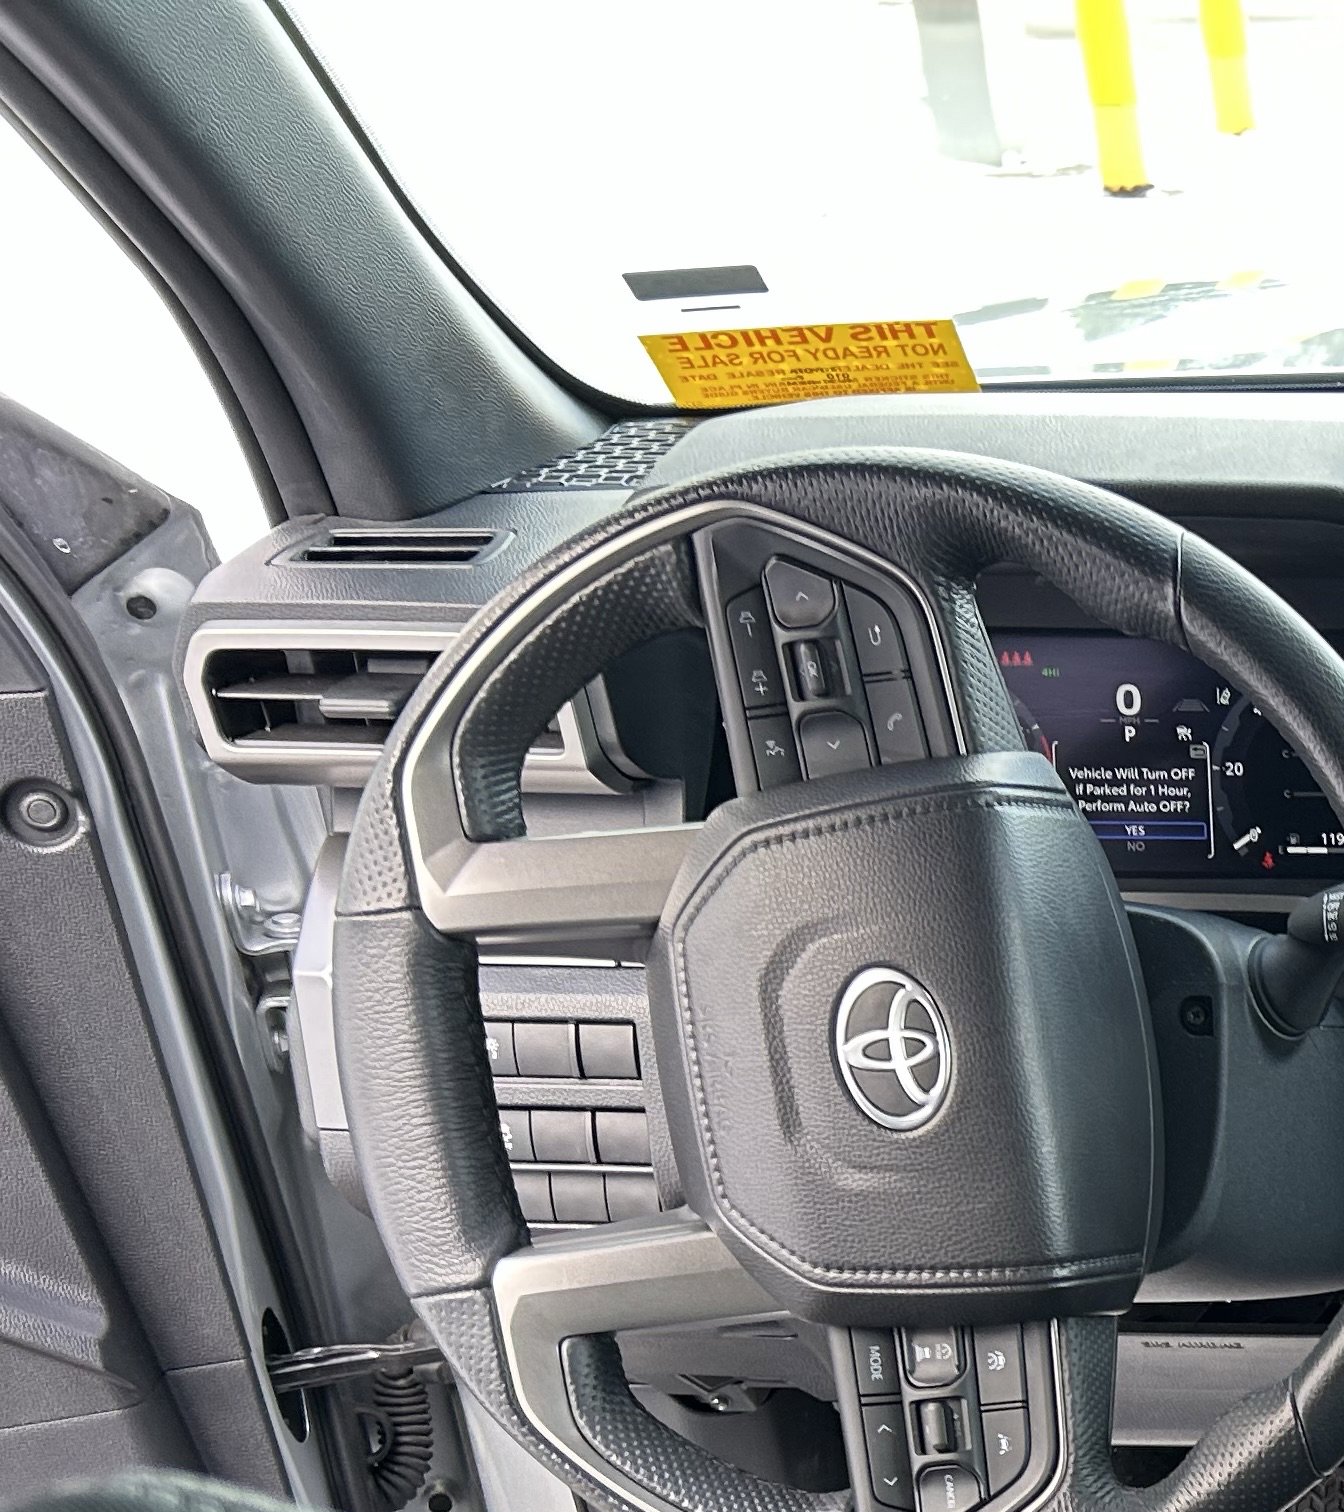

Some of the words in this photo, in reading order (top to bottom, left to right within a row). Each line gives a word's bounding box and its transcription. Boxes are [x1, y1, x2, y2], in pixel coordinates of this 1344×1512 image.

[1115, 683, 1142, 716] 0
[1124, 725, 1136, 742] P
[1069, 766, 1112, 780] Vehicle
[1115, 767, 1139, 780] Will
[1141, 768, 1169, 780] Turn
[1171, 768, 1196, 780] OFF
[1225, 762, 1244, 776] 20
[1075, 784, 1083, 796] if
[1086, 783, 1127, 796] Parked
[1130, 784, 1147, 796] for
[1158, 785, 1192, 798] Hour,
[1078, 800, 1125, 812] Perform
[1128, 800, 1157, 812] Auto
[1159, 800, 1190, 812] OFF?
[1124, 825, 1145, 836] YES
[1127, 841, 1145, 851] NO
[868, 1345, 883, 1381] MODE
